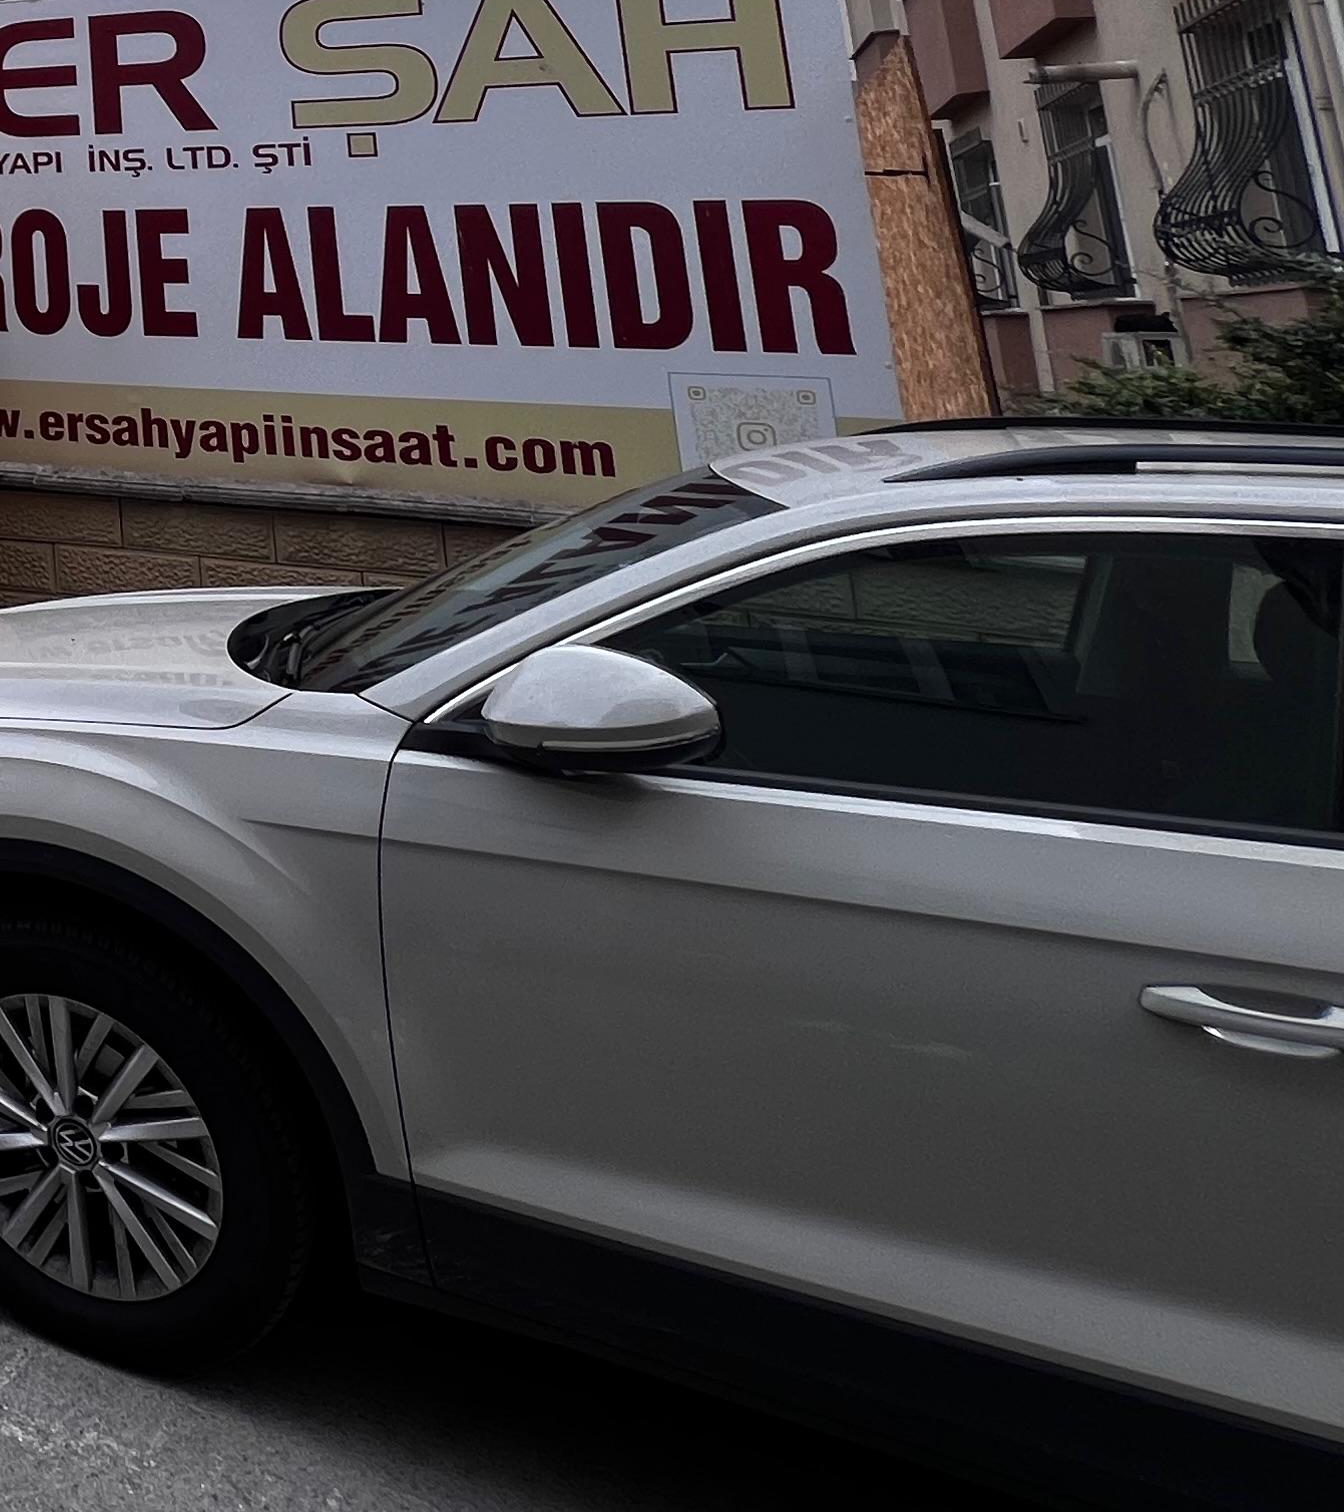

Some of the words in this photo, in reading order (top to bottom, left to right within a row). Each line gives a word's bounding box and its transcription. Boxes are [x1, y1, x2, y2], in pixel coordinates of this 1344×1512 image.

[87, 144, 154, 178] İNŞ.
[166, 144, 240, 170] LTD.
[251, 136, 313, 174] ŞTİ
[237, 199, 857, 355] ALANIDIR
